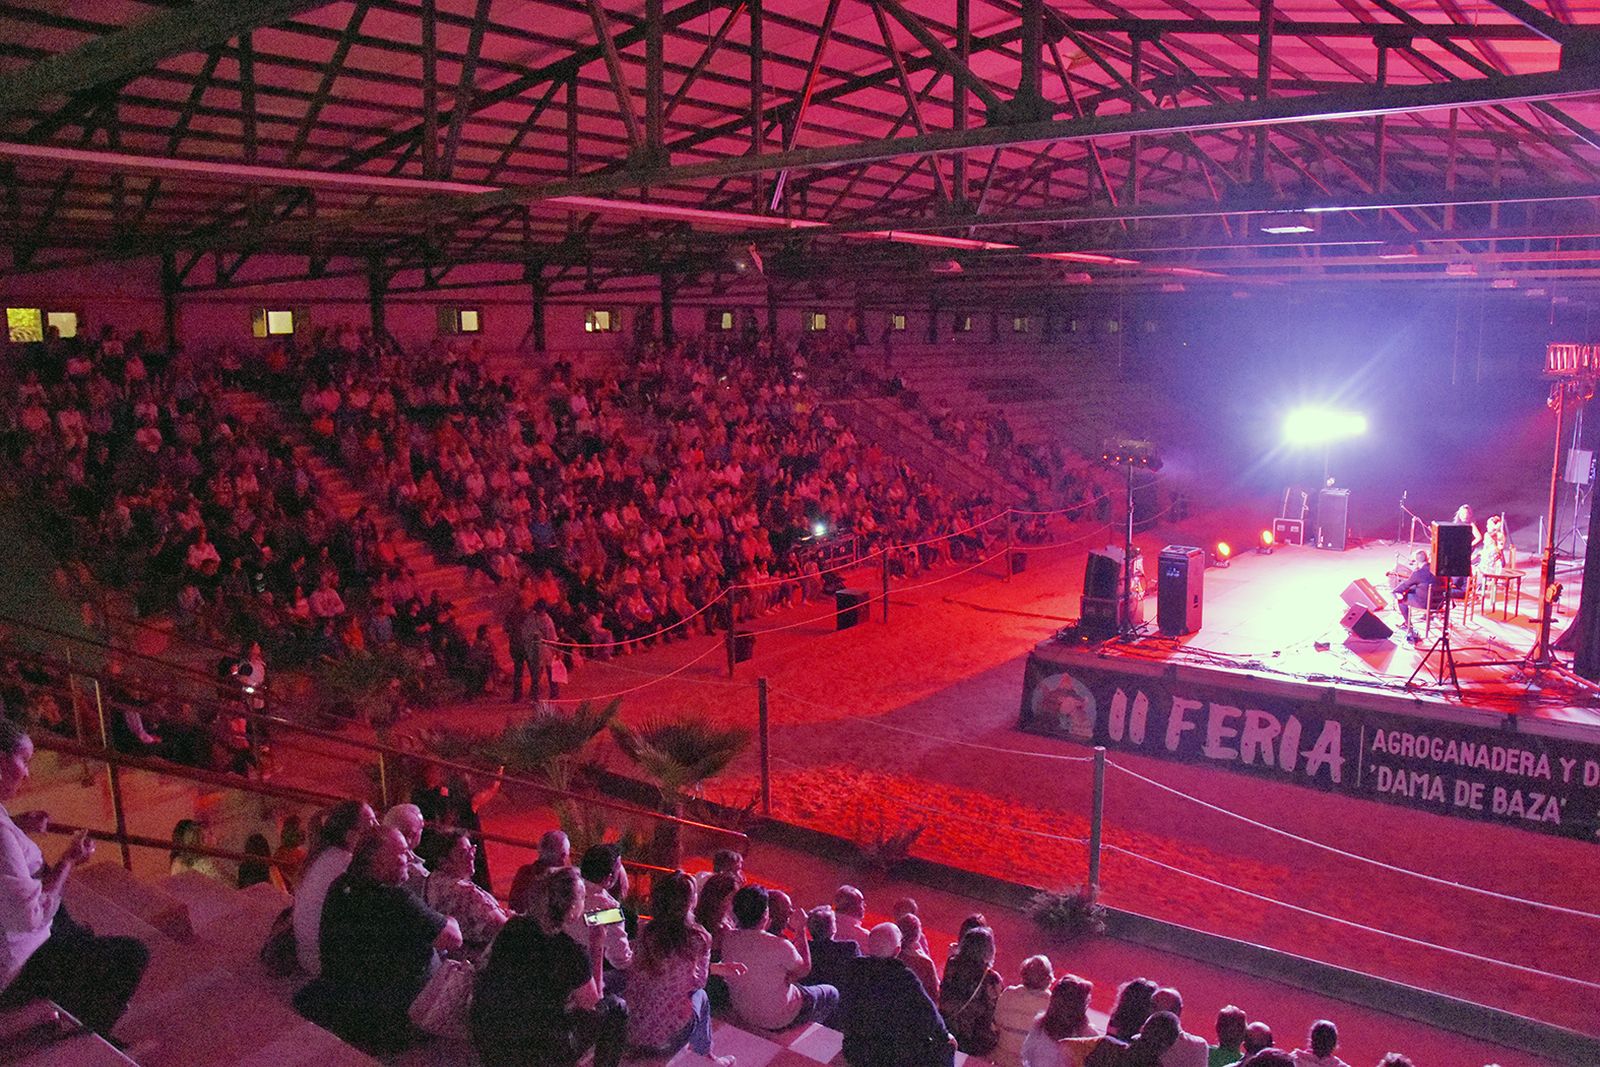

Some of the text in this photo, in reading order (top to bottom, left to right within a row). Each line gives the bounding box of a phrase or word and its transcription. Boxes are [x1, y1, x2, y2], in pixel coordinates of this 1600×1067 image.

[1108, 687, 1346, 784] II FERIA
[1371, 728, 1551, 780] AGROGANADERA
[1559, 756, 1577, 783] Y
[1454, 779, 1485, 810] DE
